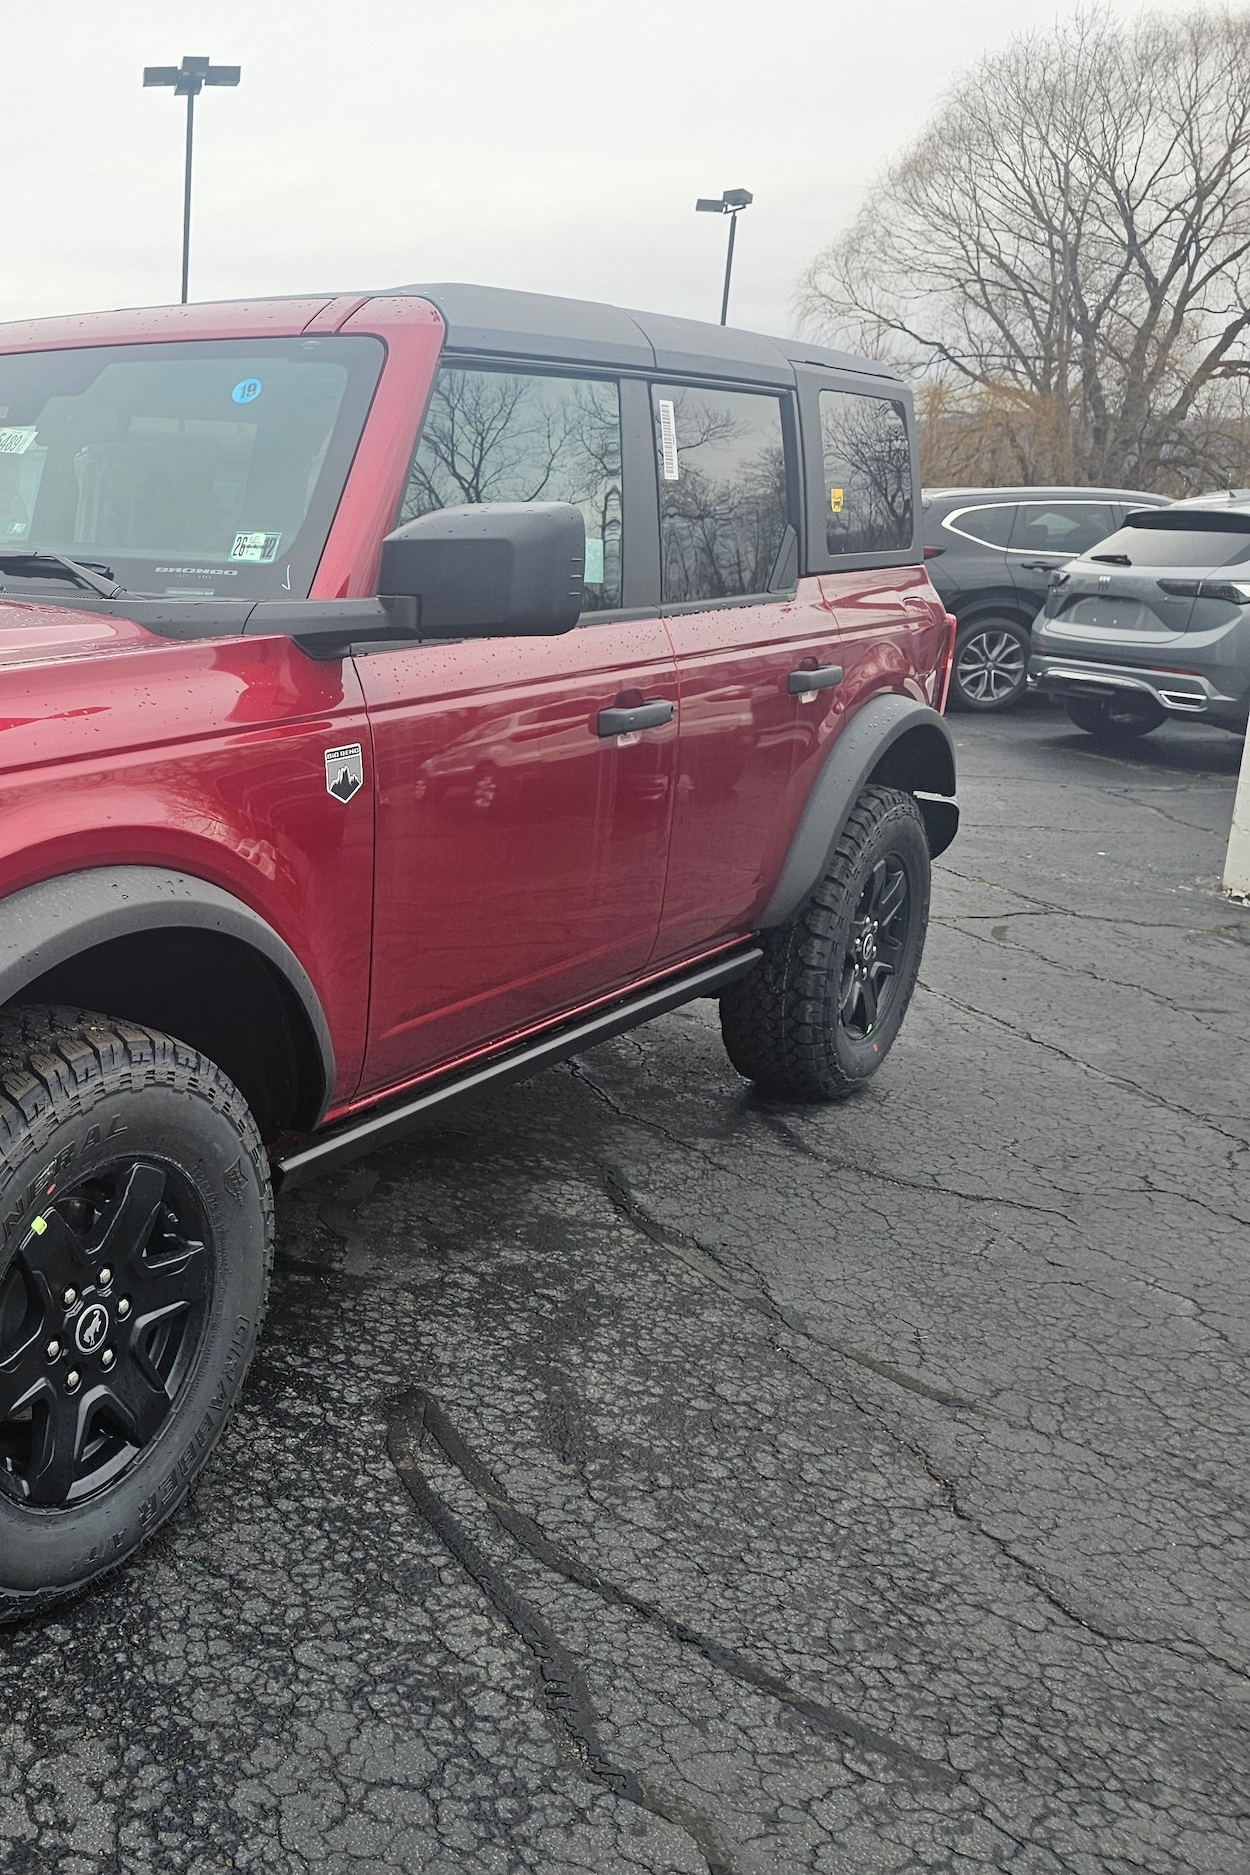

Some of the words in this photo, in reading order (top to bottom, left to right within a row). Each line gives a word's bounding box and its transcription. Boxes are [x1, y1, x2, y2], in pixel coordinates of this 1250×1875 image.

[239, 383, 258, 399] 19
[232, 536, 248, 557] 26
[261, 536, 277, 558] 12
[155, 566, 238, 576] BRONCO
[327, 751, 339, 759] BIG
[340, 747, 360, 757] BEND
[137, 1314, 250, 1529] GRABBER
